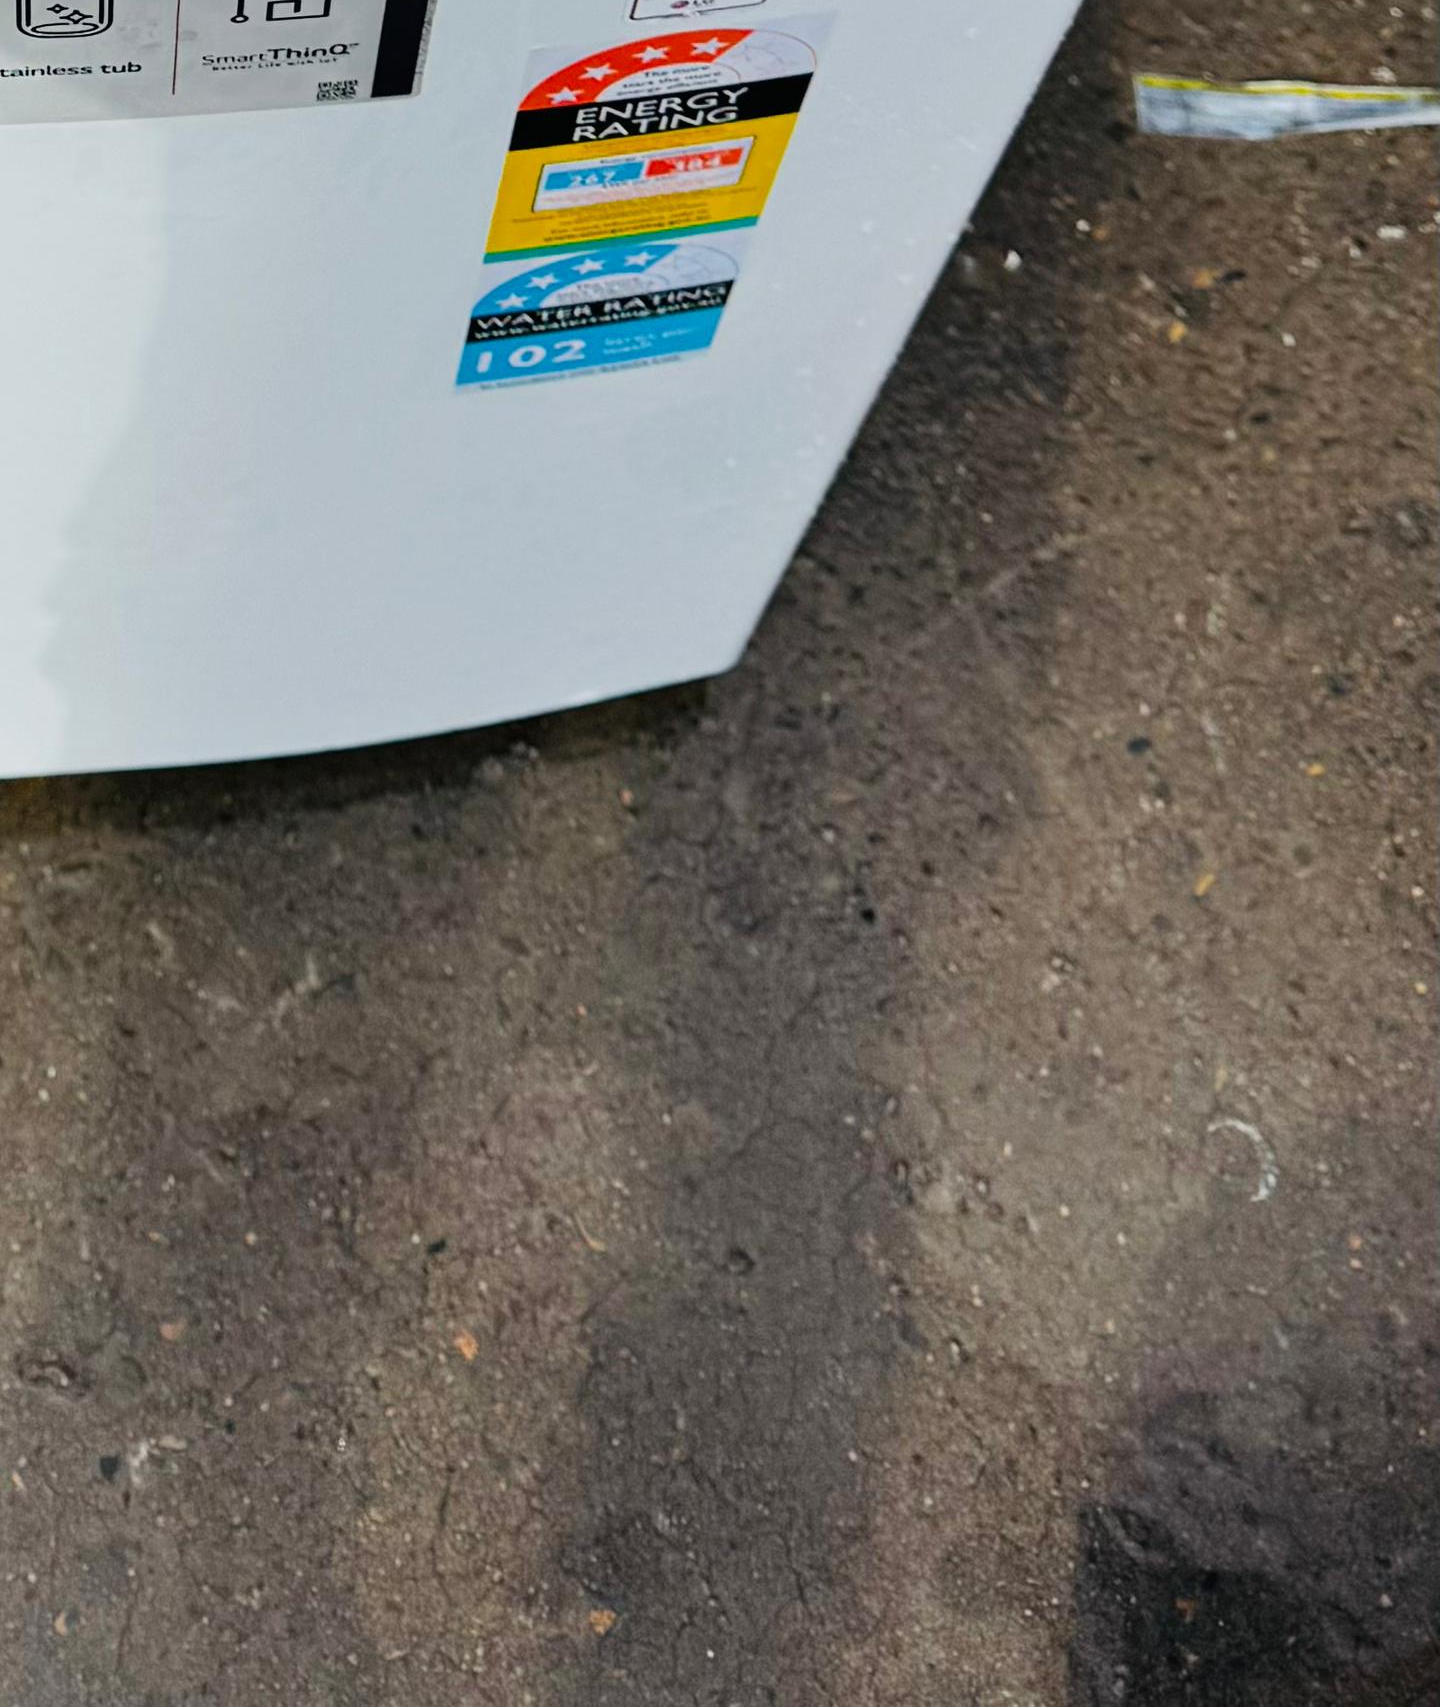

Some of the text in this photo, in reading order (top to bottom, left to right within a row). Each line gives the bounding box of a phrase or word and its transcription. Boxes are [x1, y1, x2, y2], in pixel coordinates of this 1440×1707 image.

[101, 61, 142, 75] tub
[576, 87, 748, 125] ENERGY
[573, 107, 738, 142] RATING
[477, 305, 592, 330] WATER
[477, 340, 586, 373] 102
